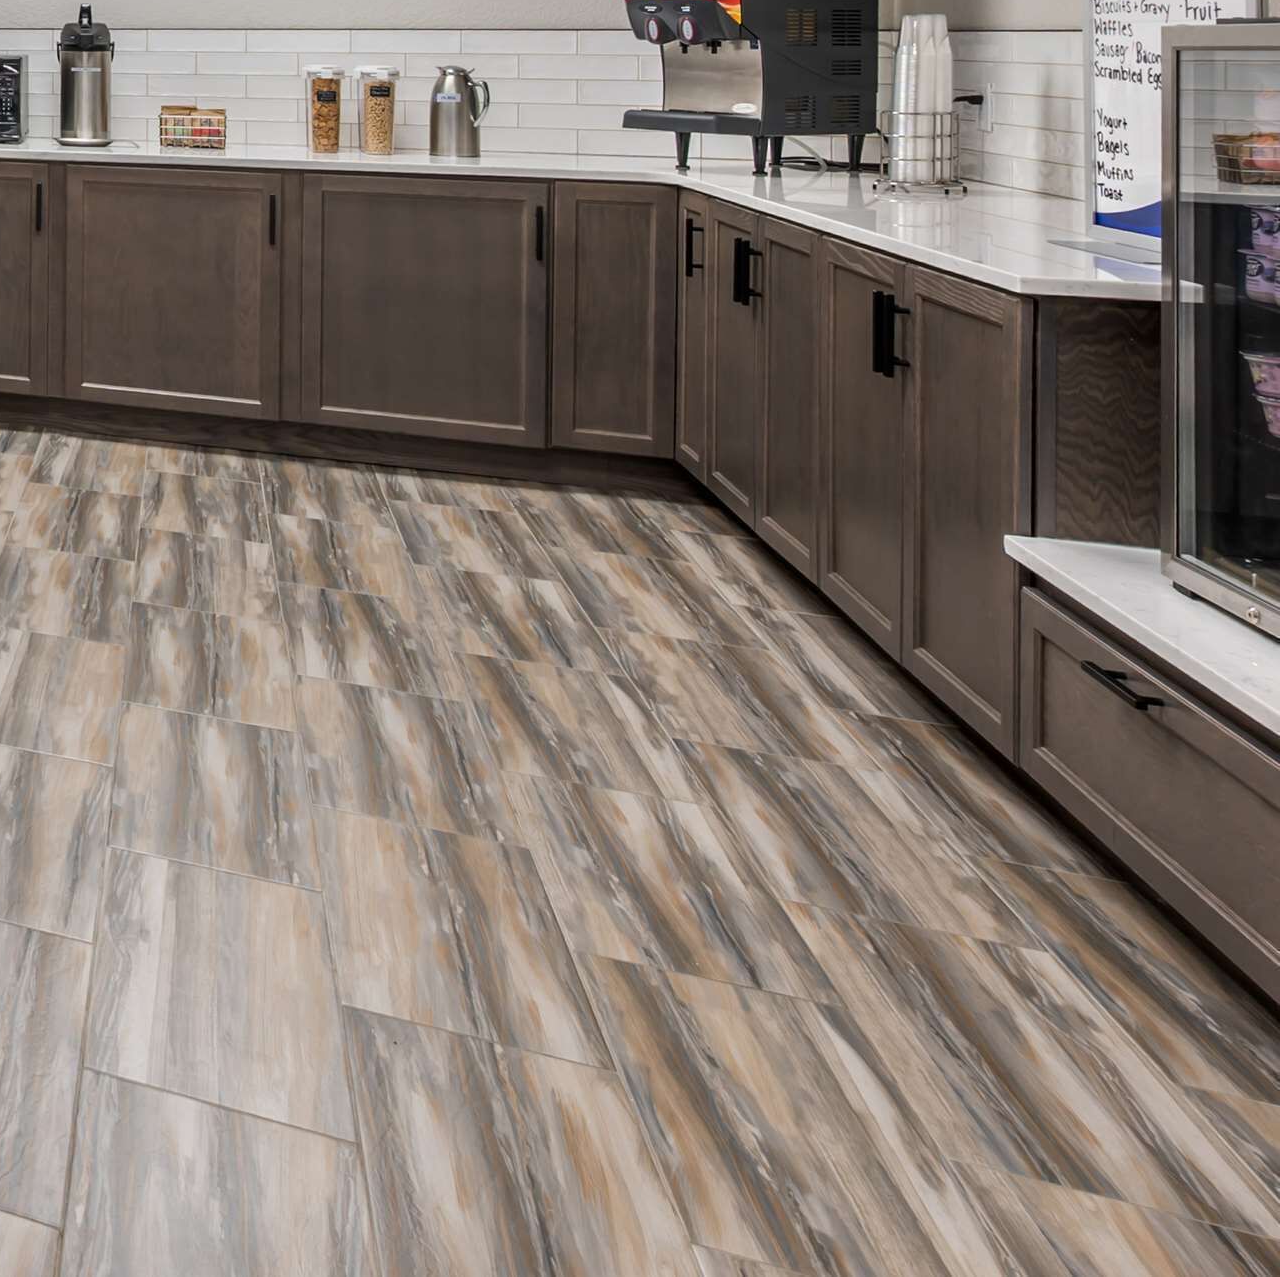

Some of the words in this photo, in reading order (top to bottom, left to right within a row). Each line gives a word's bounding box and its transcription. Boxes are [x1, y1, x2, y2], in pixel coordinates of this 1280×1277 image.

[1094, 17, 1133, 38] Waffles
[1094, 60, 1143, 85] Scrambled
[1096, 107, 1128, 135] Yogurt
[1096, 131, 1130, 161] Bagels
[1096, 161, 1134, 181] Muffins
[1096, 183, 1124, 202] Toast
